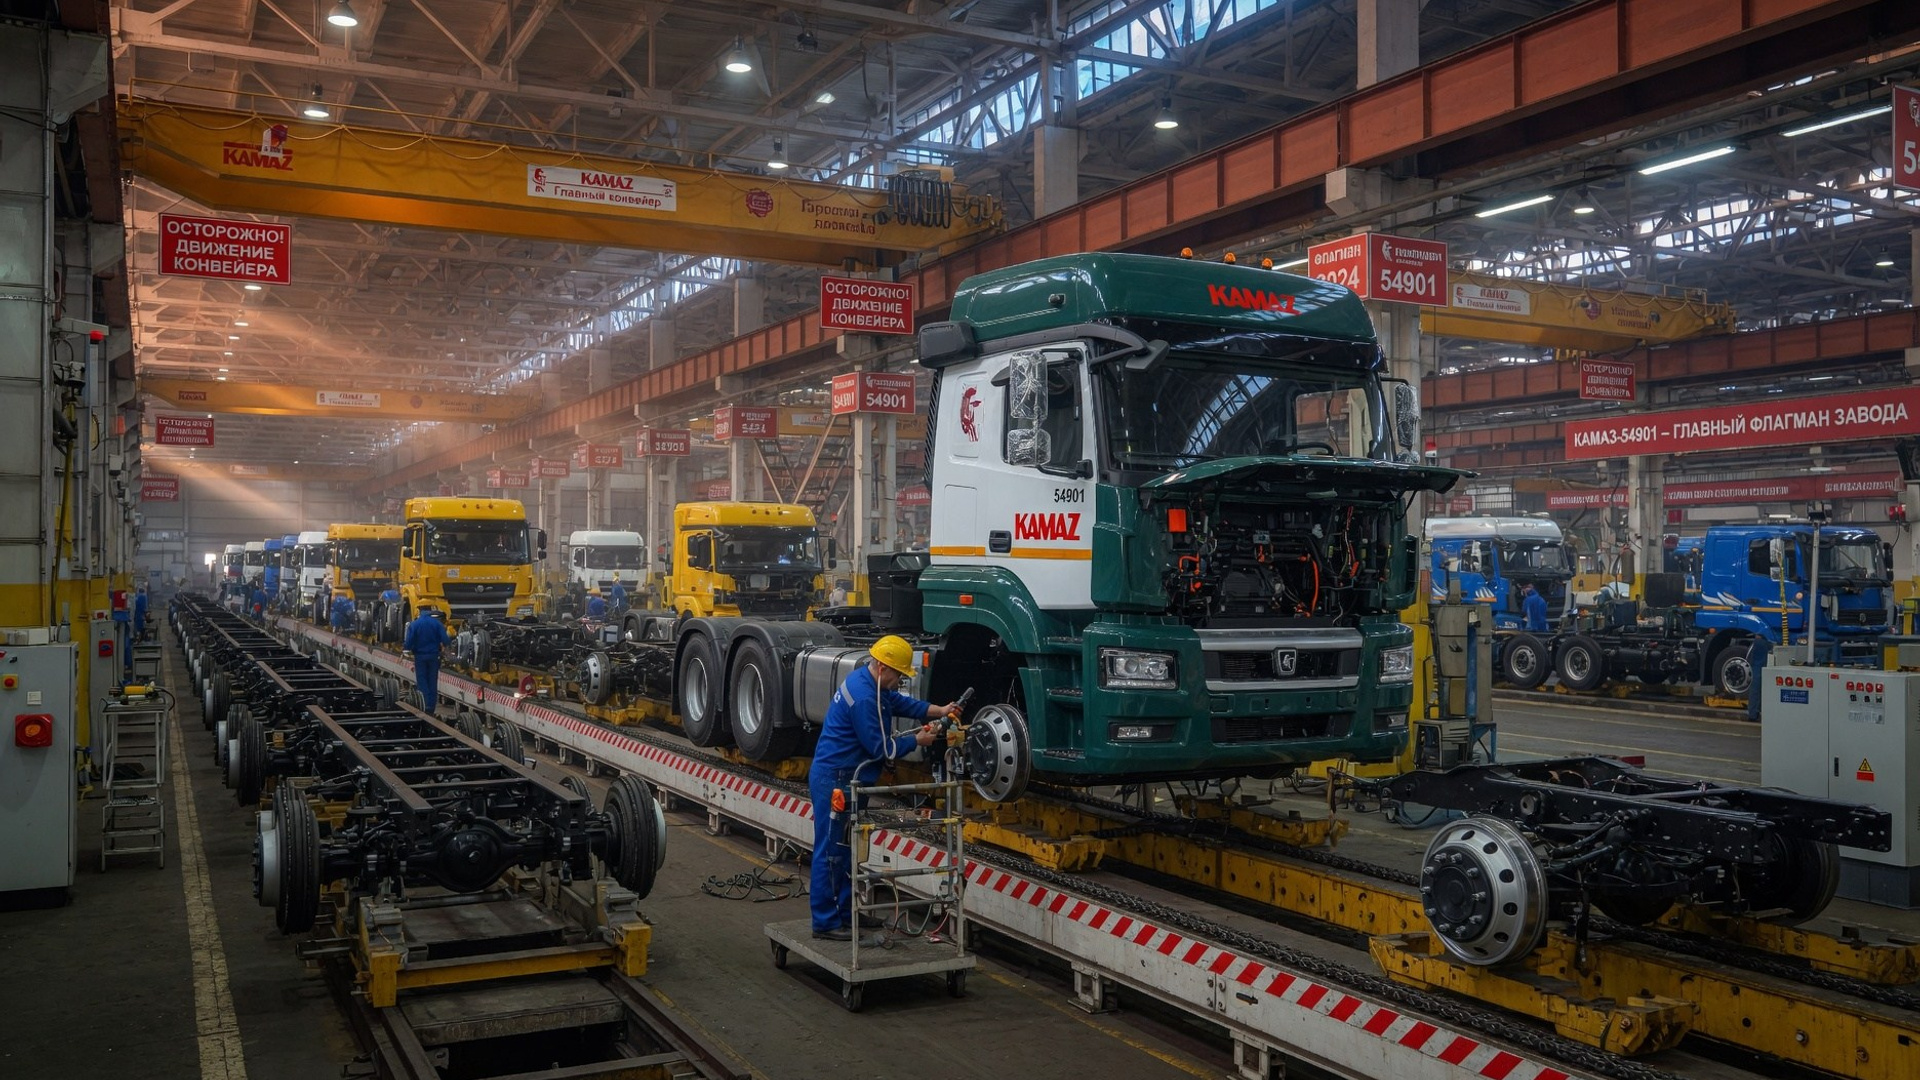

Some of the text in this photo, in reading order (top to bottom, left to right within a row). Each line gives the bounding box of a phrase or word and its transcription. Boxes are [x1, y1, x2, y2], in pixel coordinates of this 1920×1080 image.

[222, 147, 294, 171] KAMAZ
[1903, 139, 1920, 175] 5
[580, 171, 634, 190] KAMAZ
[166, 220, 285, 244] ОСТОРОЖНО!
[175, 239, 275, 260] ДВИЖЕНИЕ
[173, 256, 279, 278] КОНВЕЙЕРА
[1316, 264, 1360, 289] 024
[825, 281, 910, 300] ОСТОРОЖНО!
[1380, 268, 1436, 297] 54901
[1207, 283, 1302, 315] KAMAZ
[865, 392, 906, 409] 54901
[1574, 425, 1657, 447] КАМАЗ-54901
[1673, 414, 1746, 439] ГЛАВНЫЙ
[1750, 409, 1830, 432] ФЛАГМАН
[1834, 402, 1909, 425] ЗАВОДА
[1053, 487, 1085, 503] 54901
[1014, 512, 1081, 541] KAMAZ
